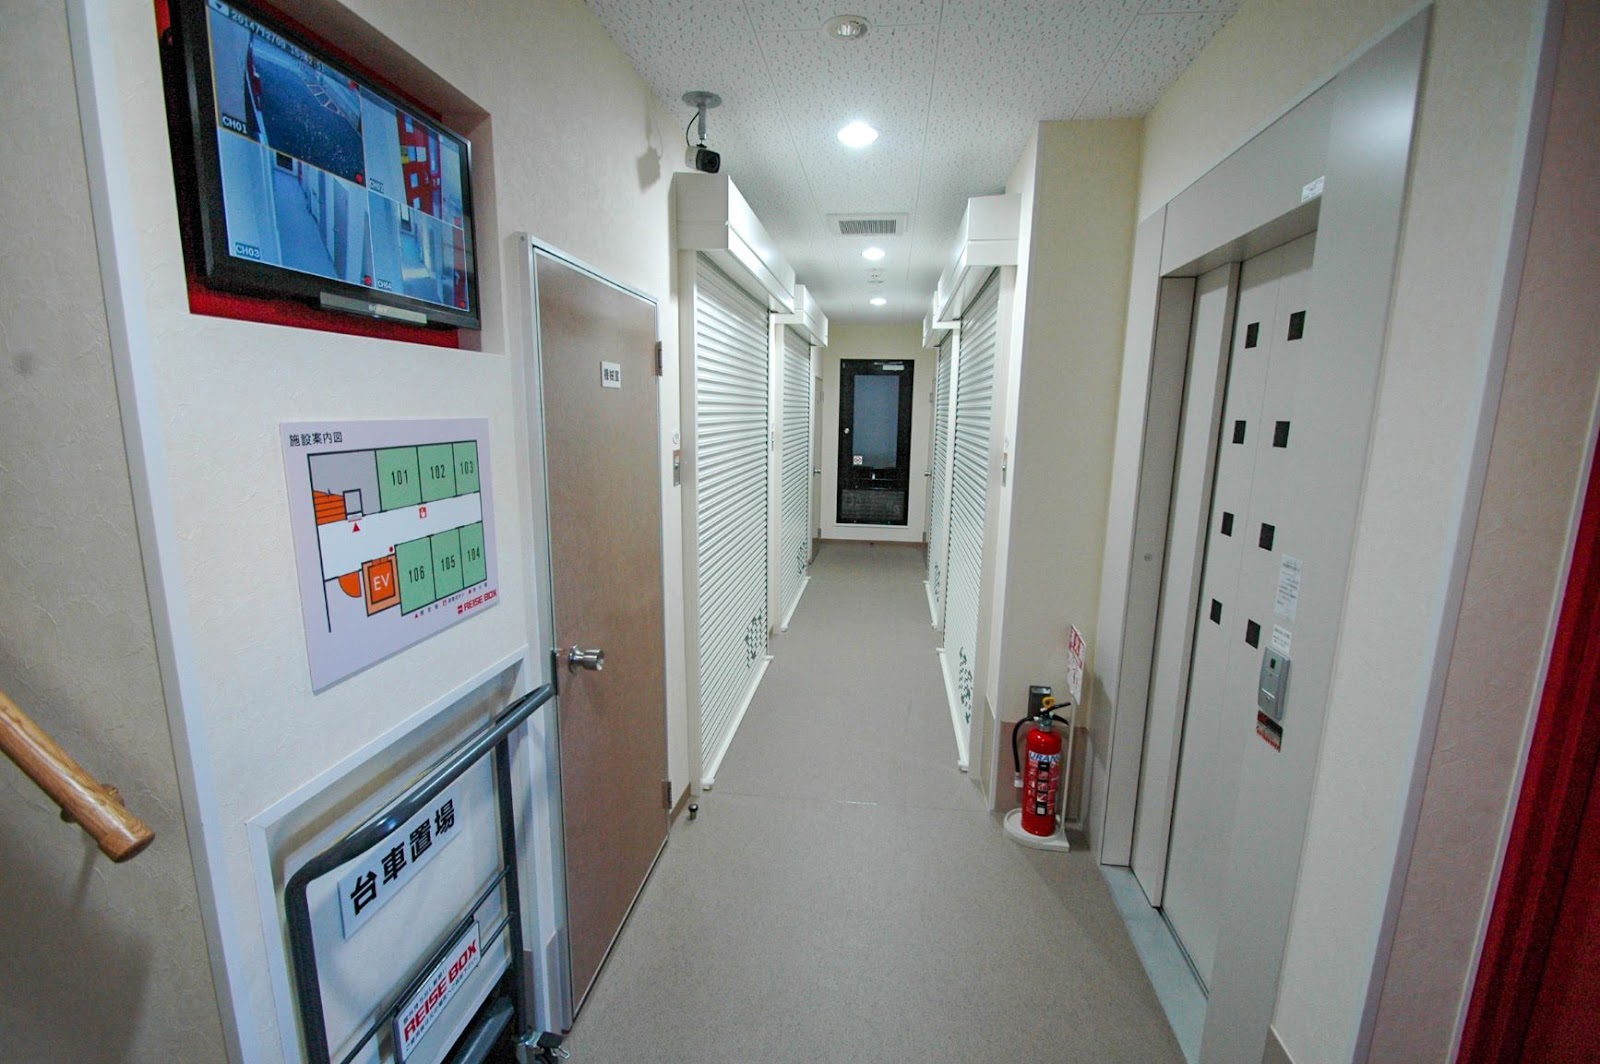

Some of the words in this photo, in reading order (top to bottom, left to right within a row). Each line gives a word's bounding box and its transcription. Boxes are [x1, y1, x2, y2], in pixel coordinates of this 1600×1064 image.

[222, 116, 247, 133] CH01
[236, 244, 260, 258] CH03
[289, 431, 343, 447] 施設案内図
[391, 469, 409, 486] 101
[430, 464, 446, 480] 102
[460, 460, 474, 475] 103
[373, 573, 391, 591] EV
[408, 565, 426, 583] 106
[441, 554, 456, 572] 105
[467, 546, 481, 562] 104
[350, 798, 455, 916] 台車置場
[403, 976, 448, 1042] REISE
[448, 939, 477, 984] BOX
